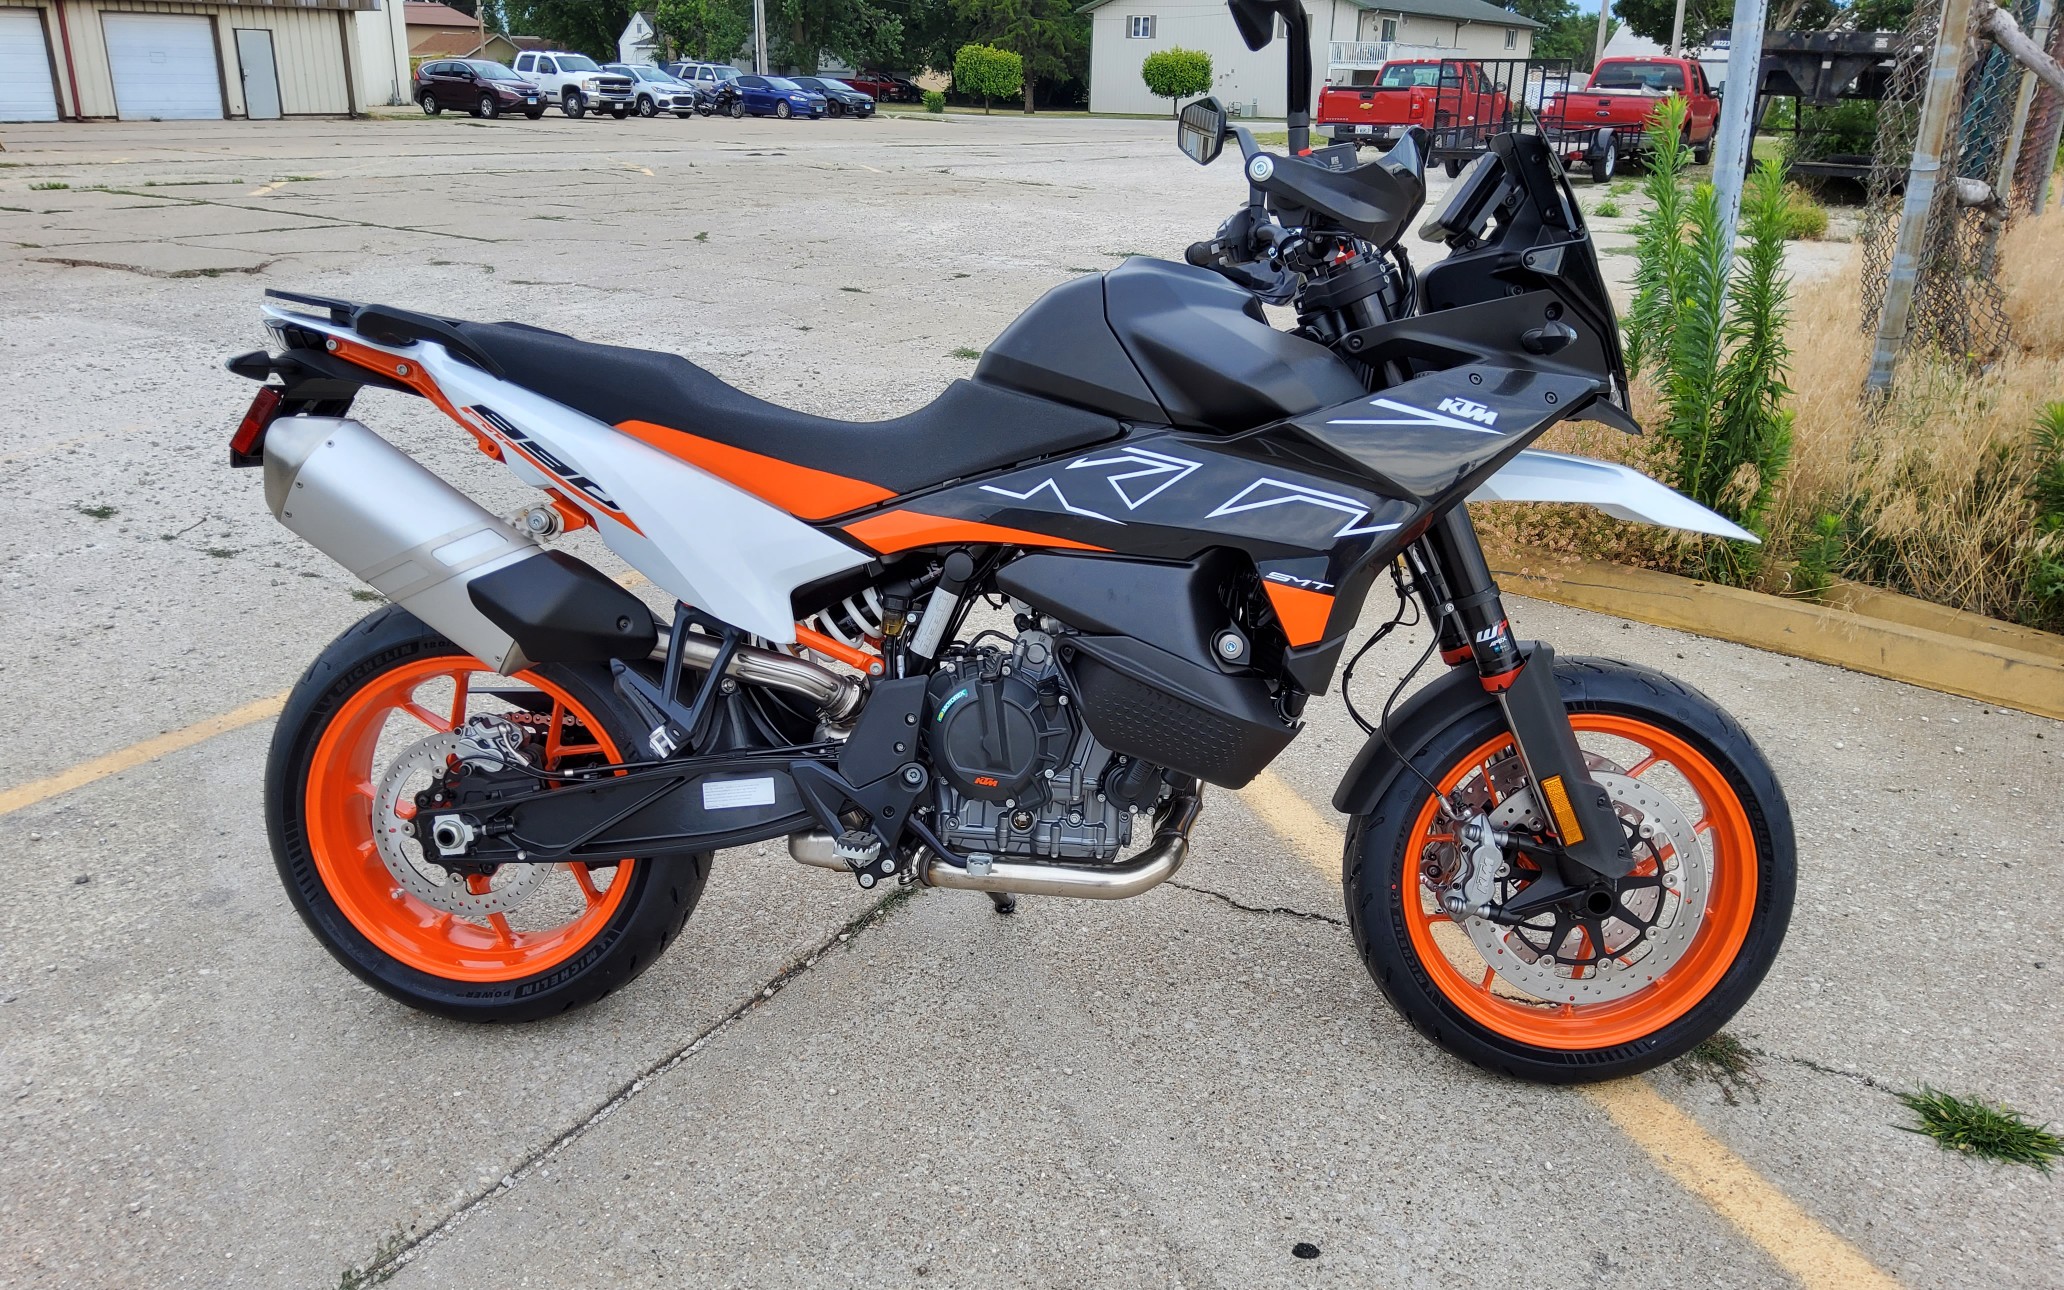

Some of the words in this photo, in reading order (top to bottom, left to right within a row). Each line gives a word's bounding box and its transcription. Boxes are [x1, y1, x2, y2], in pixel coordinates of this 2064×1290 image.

[1436, 396, 1499, 427] KTM
[467, 404, 622, 512] 890
[1264, 571, 1336, 589] SMT
[1476, 619, 1508, 643] WP
[335, 643, 414, 694] MICHELIN
[974, 776, 999, 788] KTM
[1475, 856, 1495, 896] KTM
[1392, 915, 1427, 984] MICHELIN
[521, 949, 598, 996] MICHELIN
[465, 989, 511, 998] POWER
